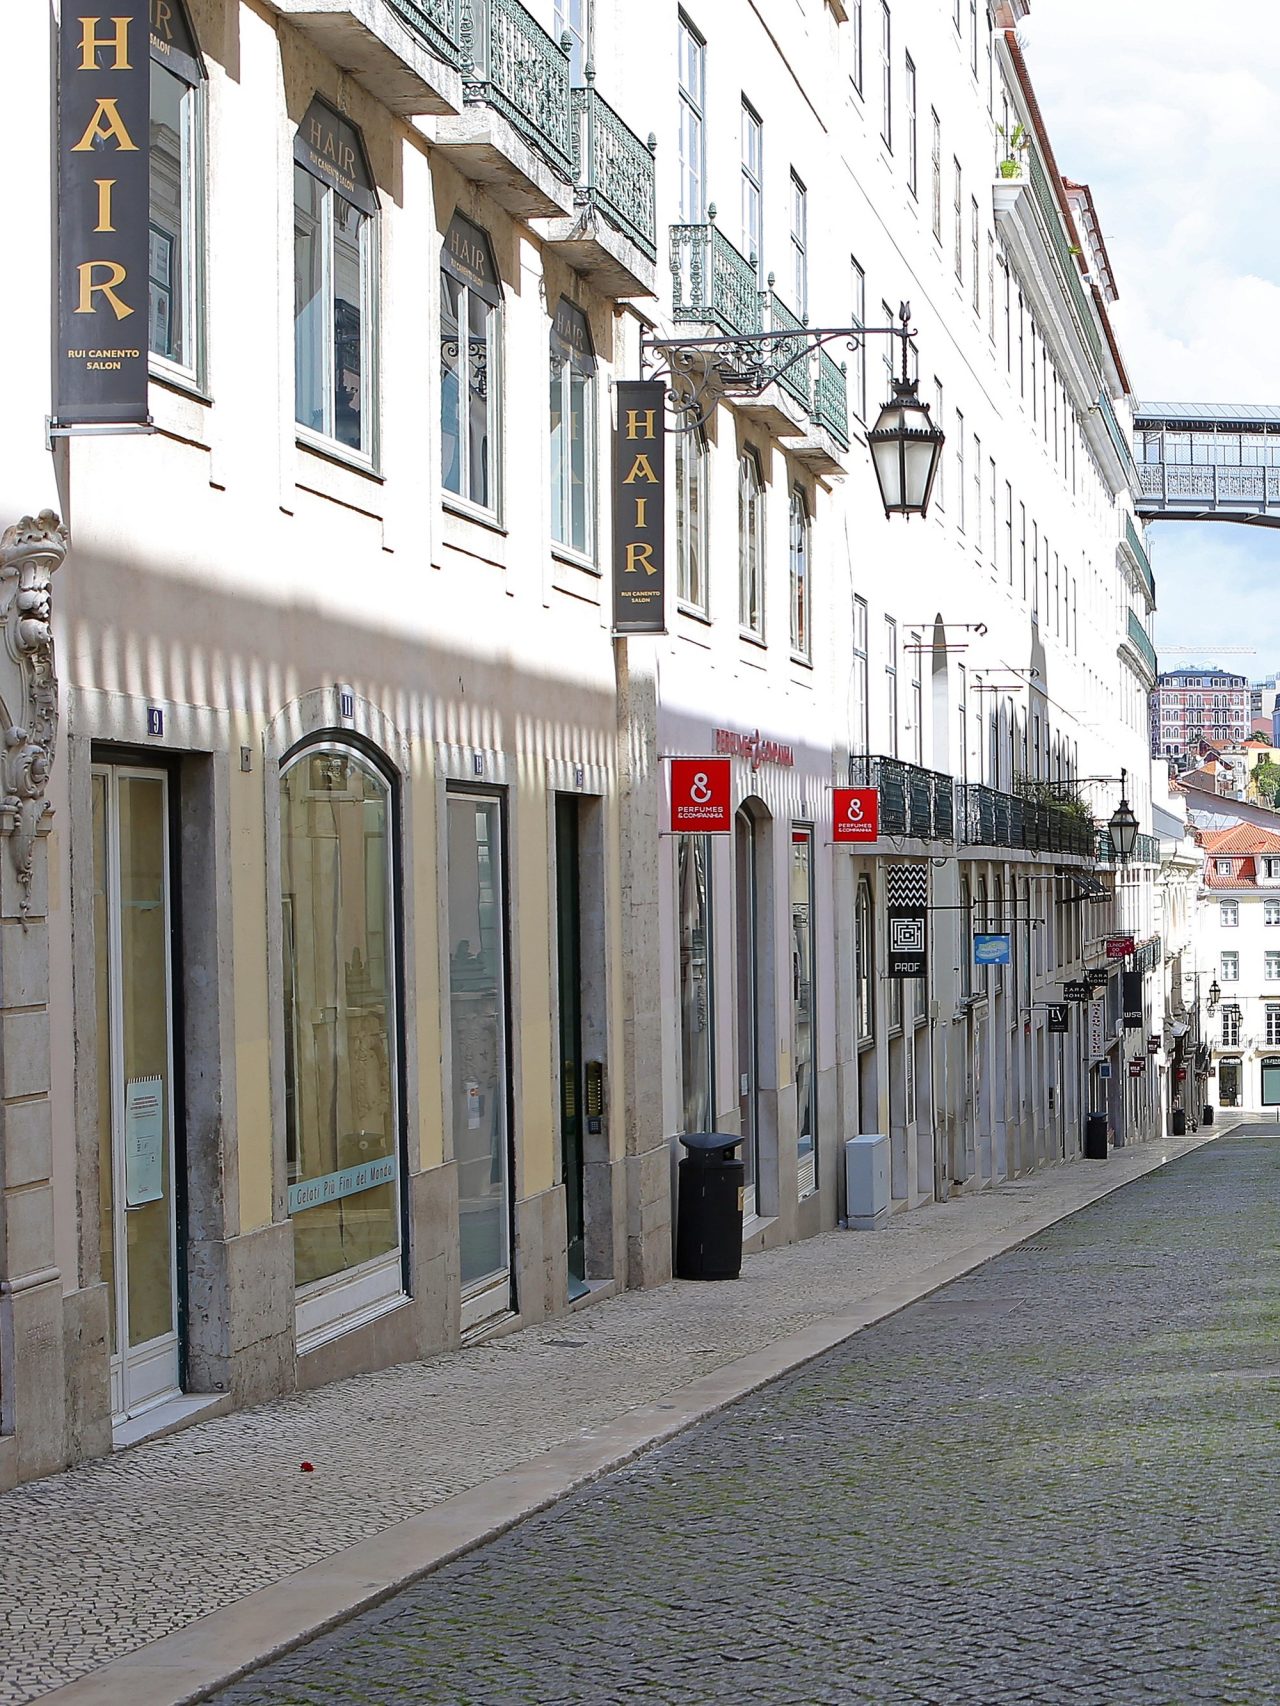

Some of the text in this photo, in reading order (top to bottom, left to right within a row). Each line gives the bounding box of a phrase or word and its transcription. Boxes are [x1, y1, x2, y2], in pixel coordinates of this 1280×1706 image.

[310, 118, 356, 179] HAIR
[70, 17, 140, 321] HAIR
[451, 230, 485, 276] HAIR
[556, 312, 584, 350] HAIR
[68, 350, 140, 358] RUI CANENTO
[86, 362, 121, 370] SALON
[622, 409, 660, 576] HAIR
[344, 695, 351, 717] 11
[152, 710, 160, 734] 9
[690, 772, 712, 803] &
[848, 798, 864, 821] &
[894, 962, 920, 972] PROF
[296, 1185, 320, 1205] Gelati
[324, 1180, 334, 1196] Più
[340, 1176, 352, 1190] Fini
[356, 1170, 366, 1186] del
[370, 1164, 392, 1181] Mondo
